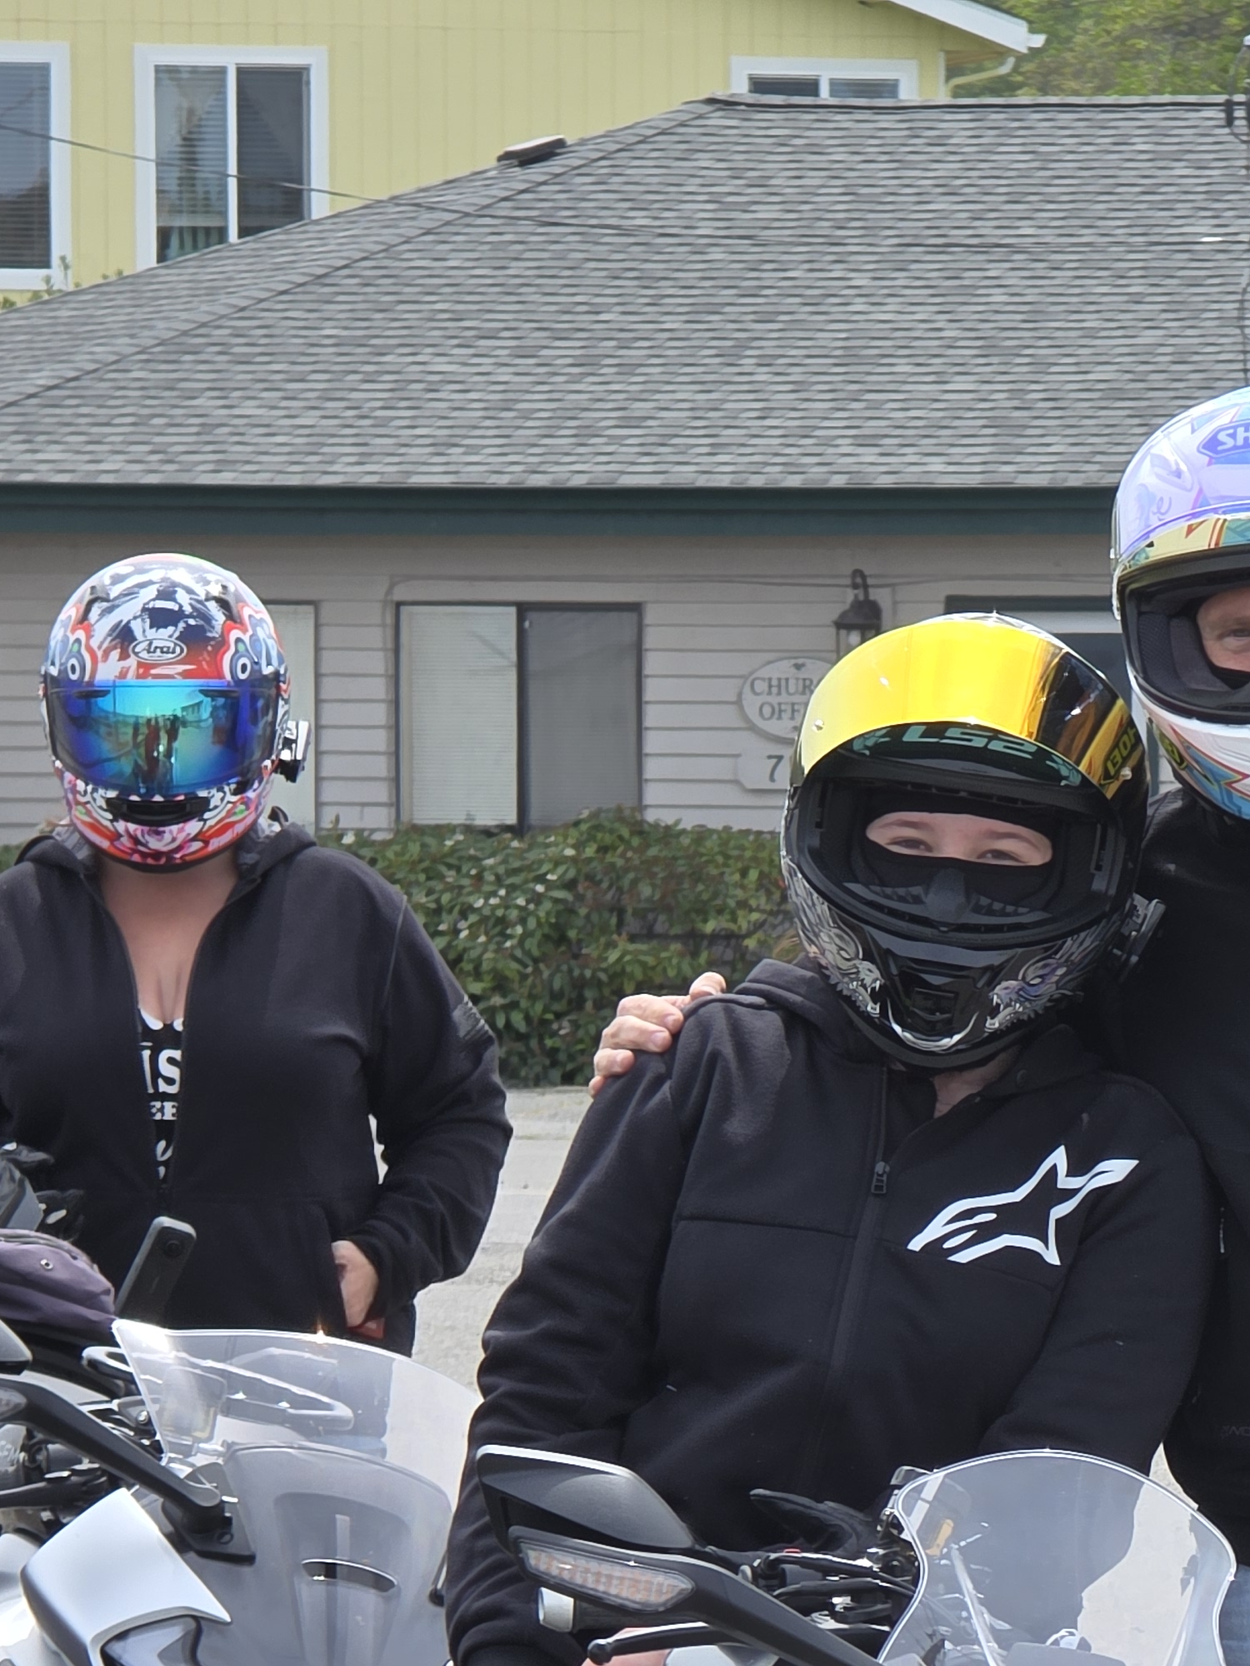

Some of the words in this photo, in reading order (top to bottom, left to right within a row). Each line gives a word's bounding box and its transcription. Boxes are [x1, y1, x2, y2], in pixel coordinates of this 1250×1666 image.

[135, 640, 177, 655] Arai
[750, 677, 814, 697] CHUR
[758, 702, 806, 721] OFF
[902, 725, 1038, 760] LS2
[766, 754, 784, 783] 7
